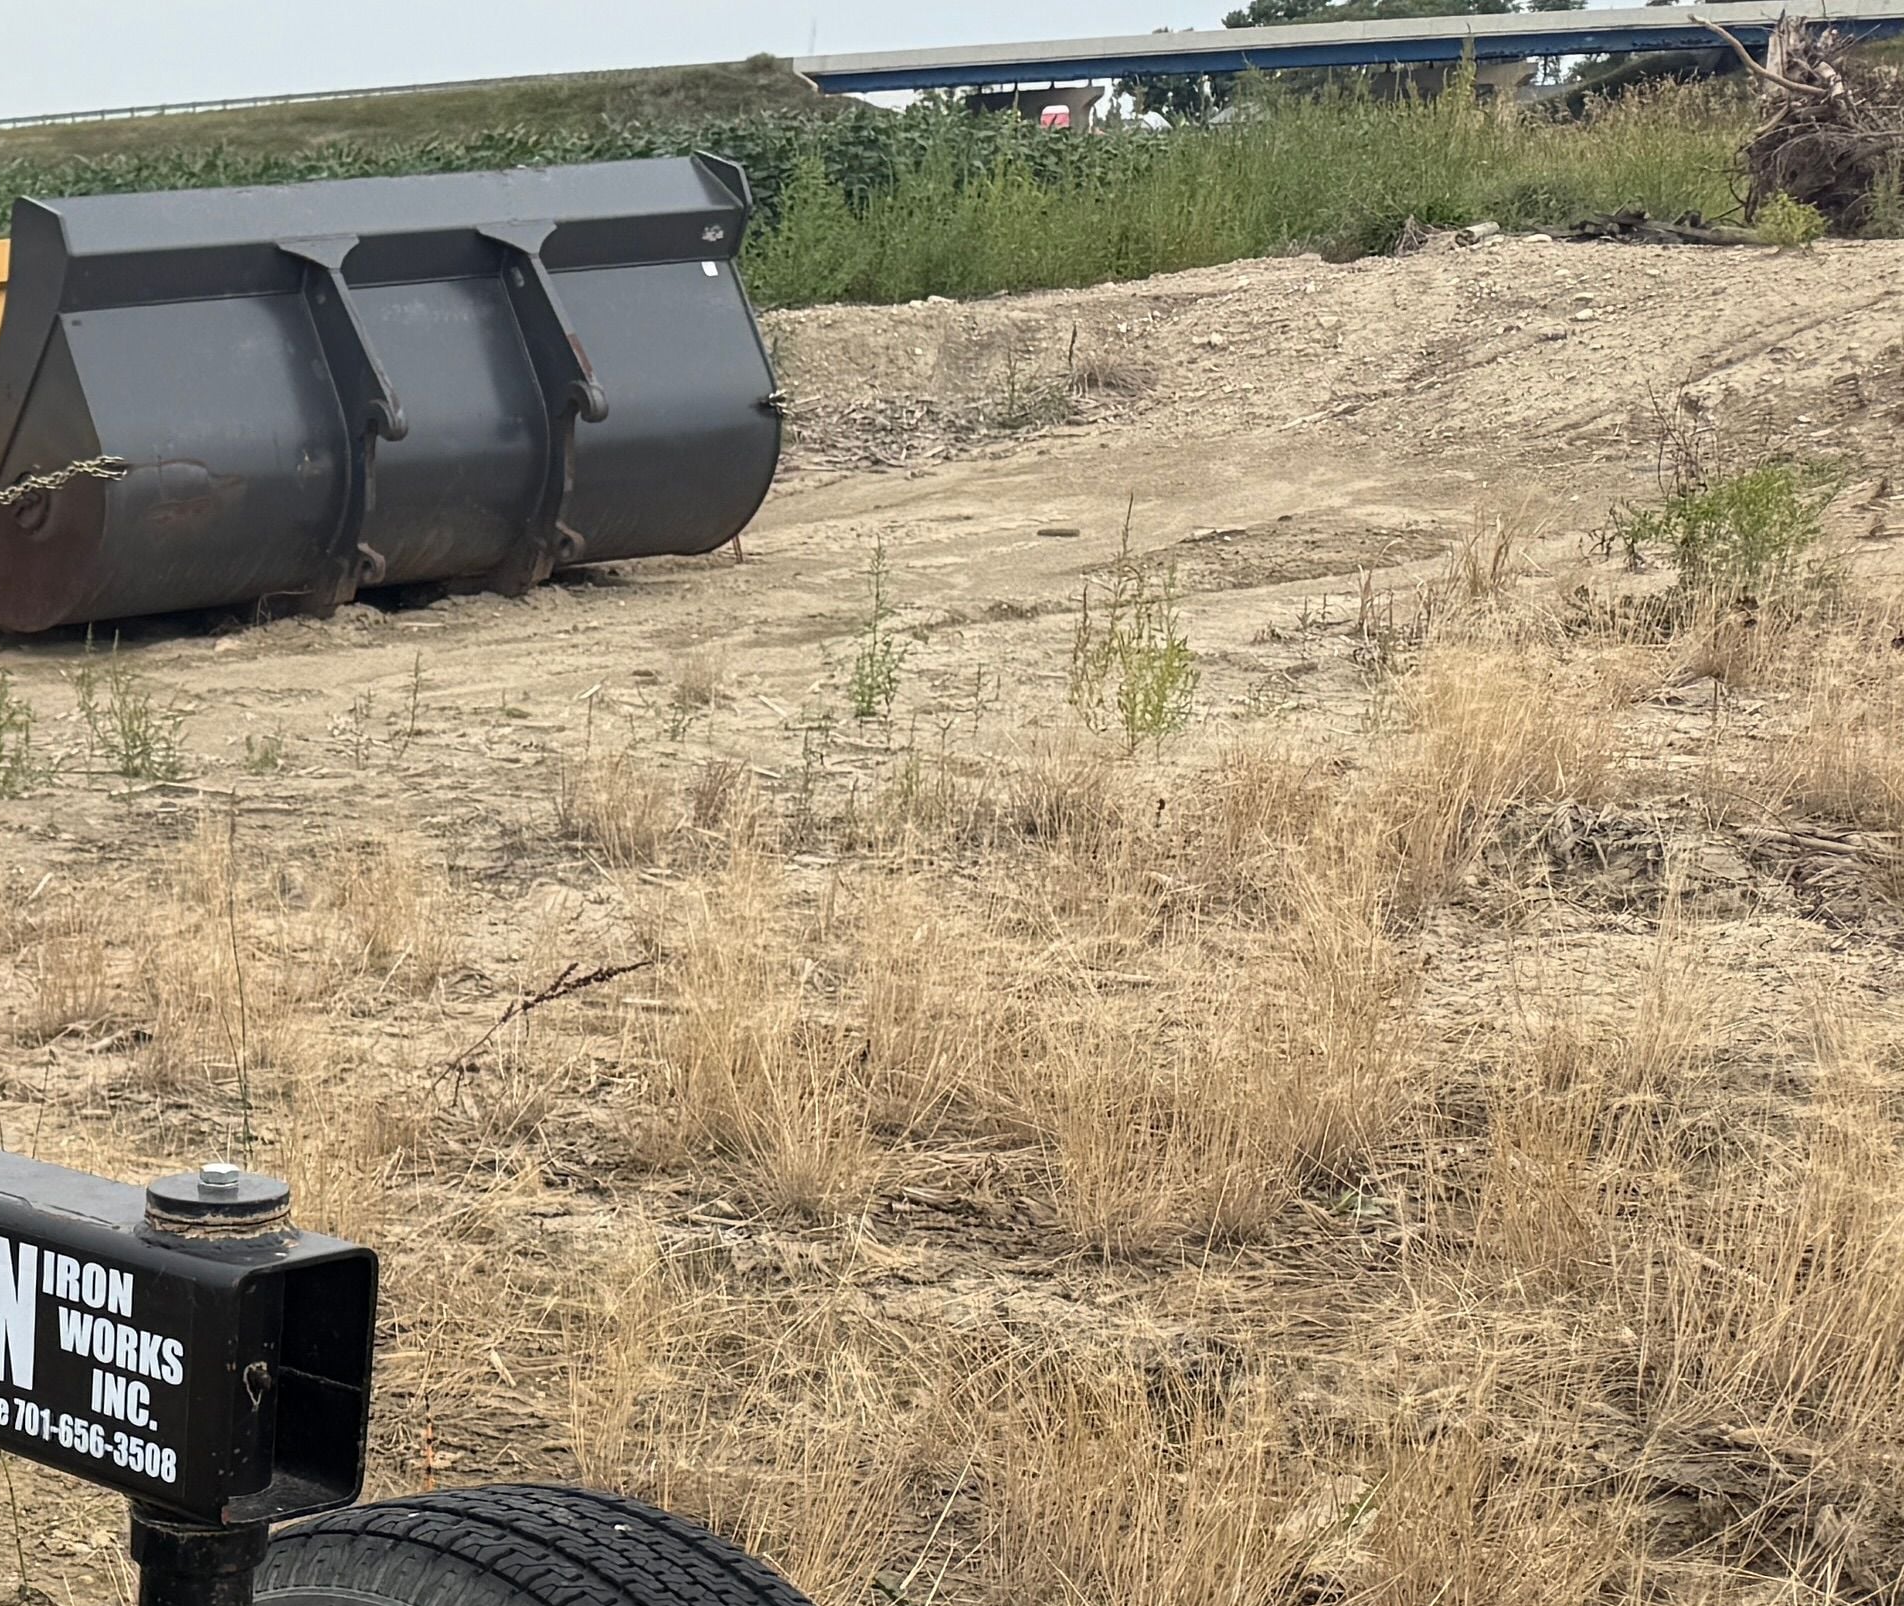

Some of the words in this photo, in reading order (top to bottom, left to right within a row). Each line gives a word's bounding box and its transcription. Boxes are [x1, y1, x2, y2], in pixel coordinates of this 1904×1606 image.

[42, 1249, 134, 1318] IRON
[58, 1306, 184, 1385] WORKS
[91, 1368, 158, 1431] INC.
[14, 1397, 177, 1484] 701-656-3508
